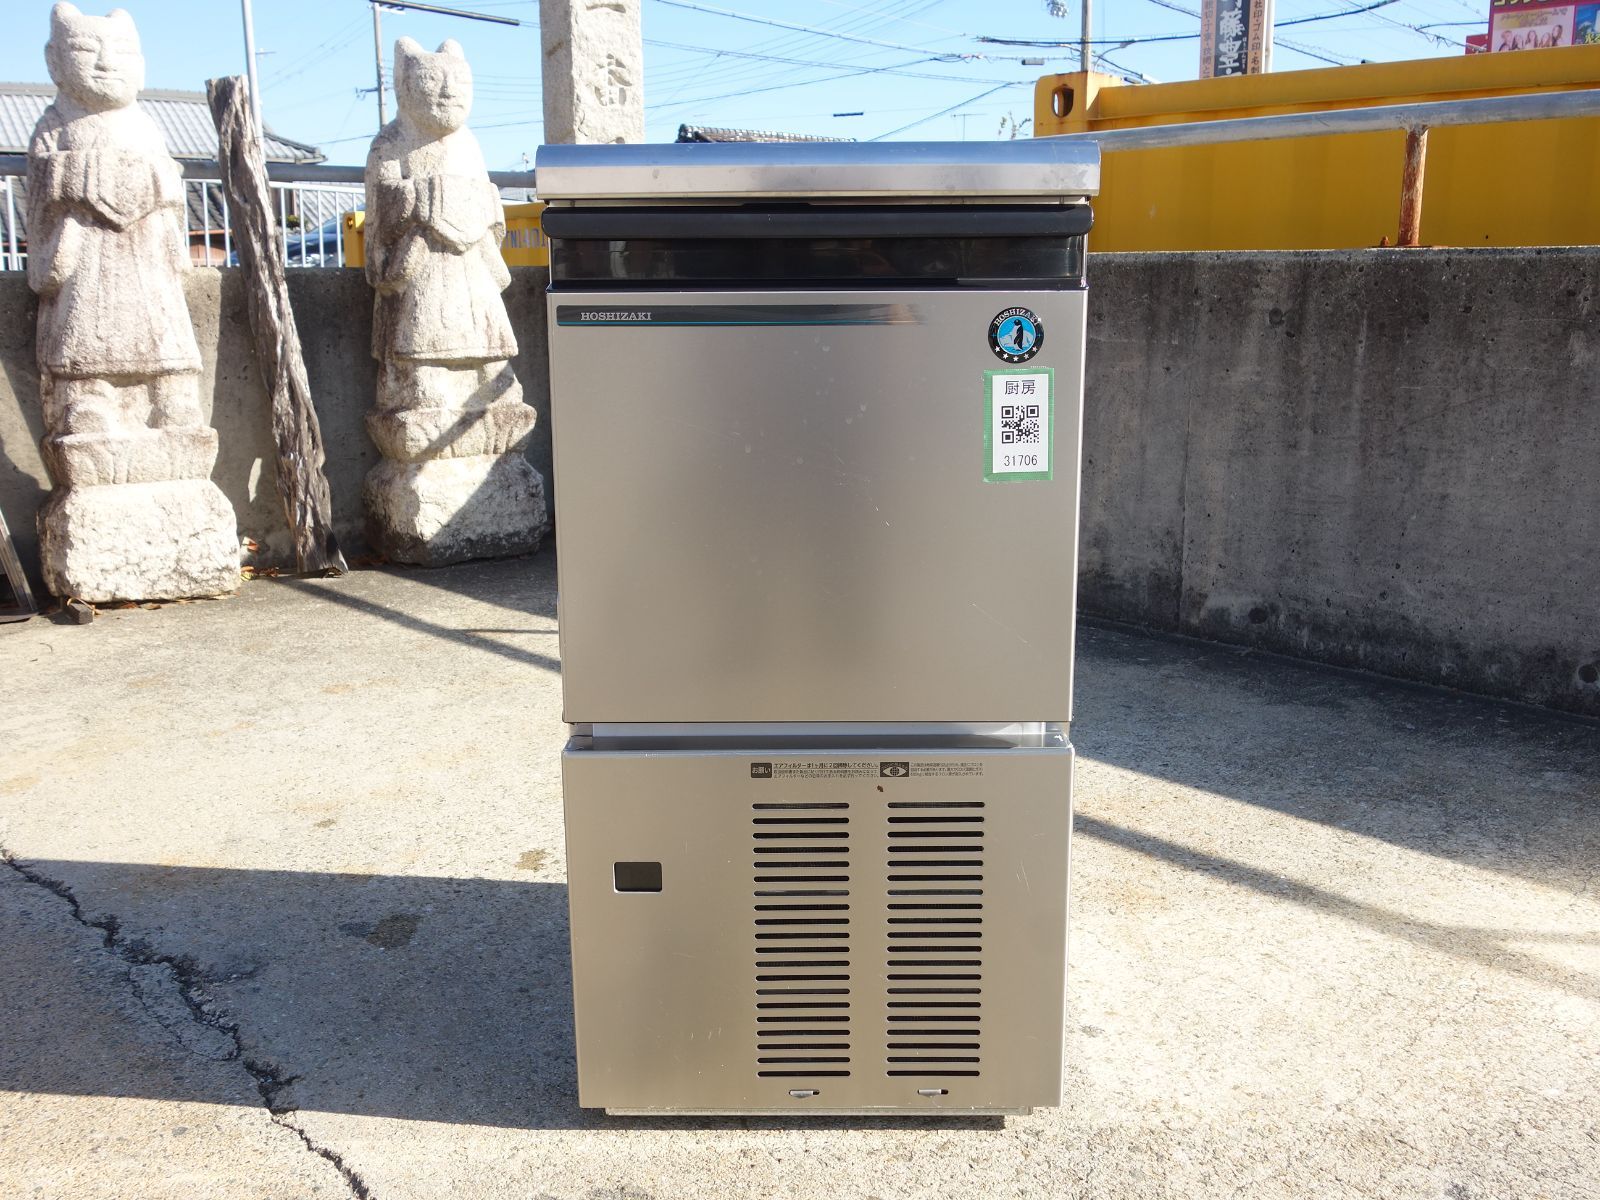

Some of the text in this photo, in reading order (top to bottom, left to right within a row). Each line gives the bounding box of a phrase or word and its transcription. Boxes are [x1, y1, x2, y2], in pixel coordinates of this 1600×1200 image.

[580, 312, 652, 321] HOSHIZAKI
[994, 308, 1040, 326] HOSHIZAKI
[1004, 379, 1036, 395] 厨房
[1003, 454, 1038, 466] 31706
